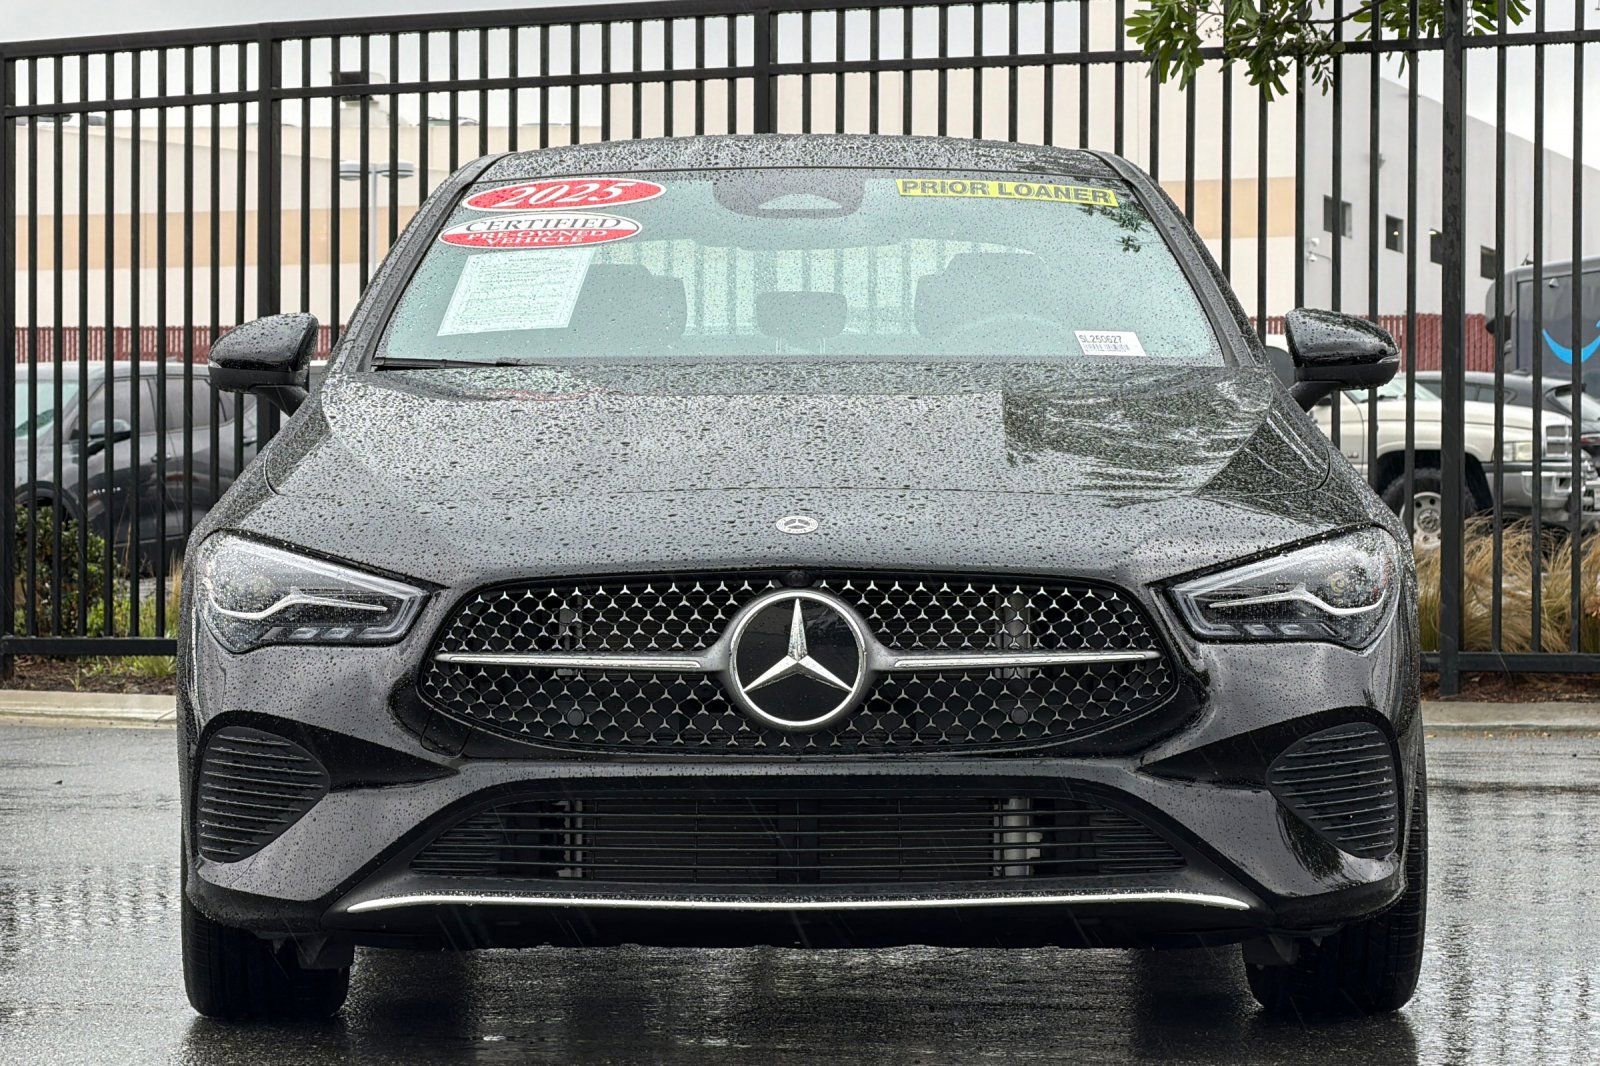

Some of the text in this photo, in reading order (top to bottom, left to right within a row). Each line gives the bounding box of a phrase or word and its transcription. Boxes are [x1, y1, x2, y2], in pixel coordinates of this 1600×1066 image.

[491, 182, 637, 207] 2025
[902, 180, 1111, 204] PRIOR LOANER
[466, 217, 621, 231] CERTIFIED
[467, 230, 608, 240] PRE-OWNED
[486, 236, 585, 245] VEHICLE
